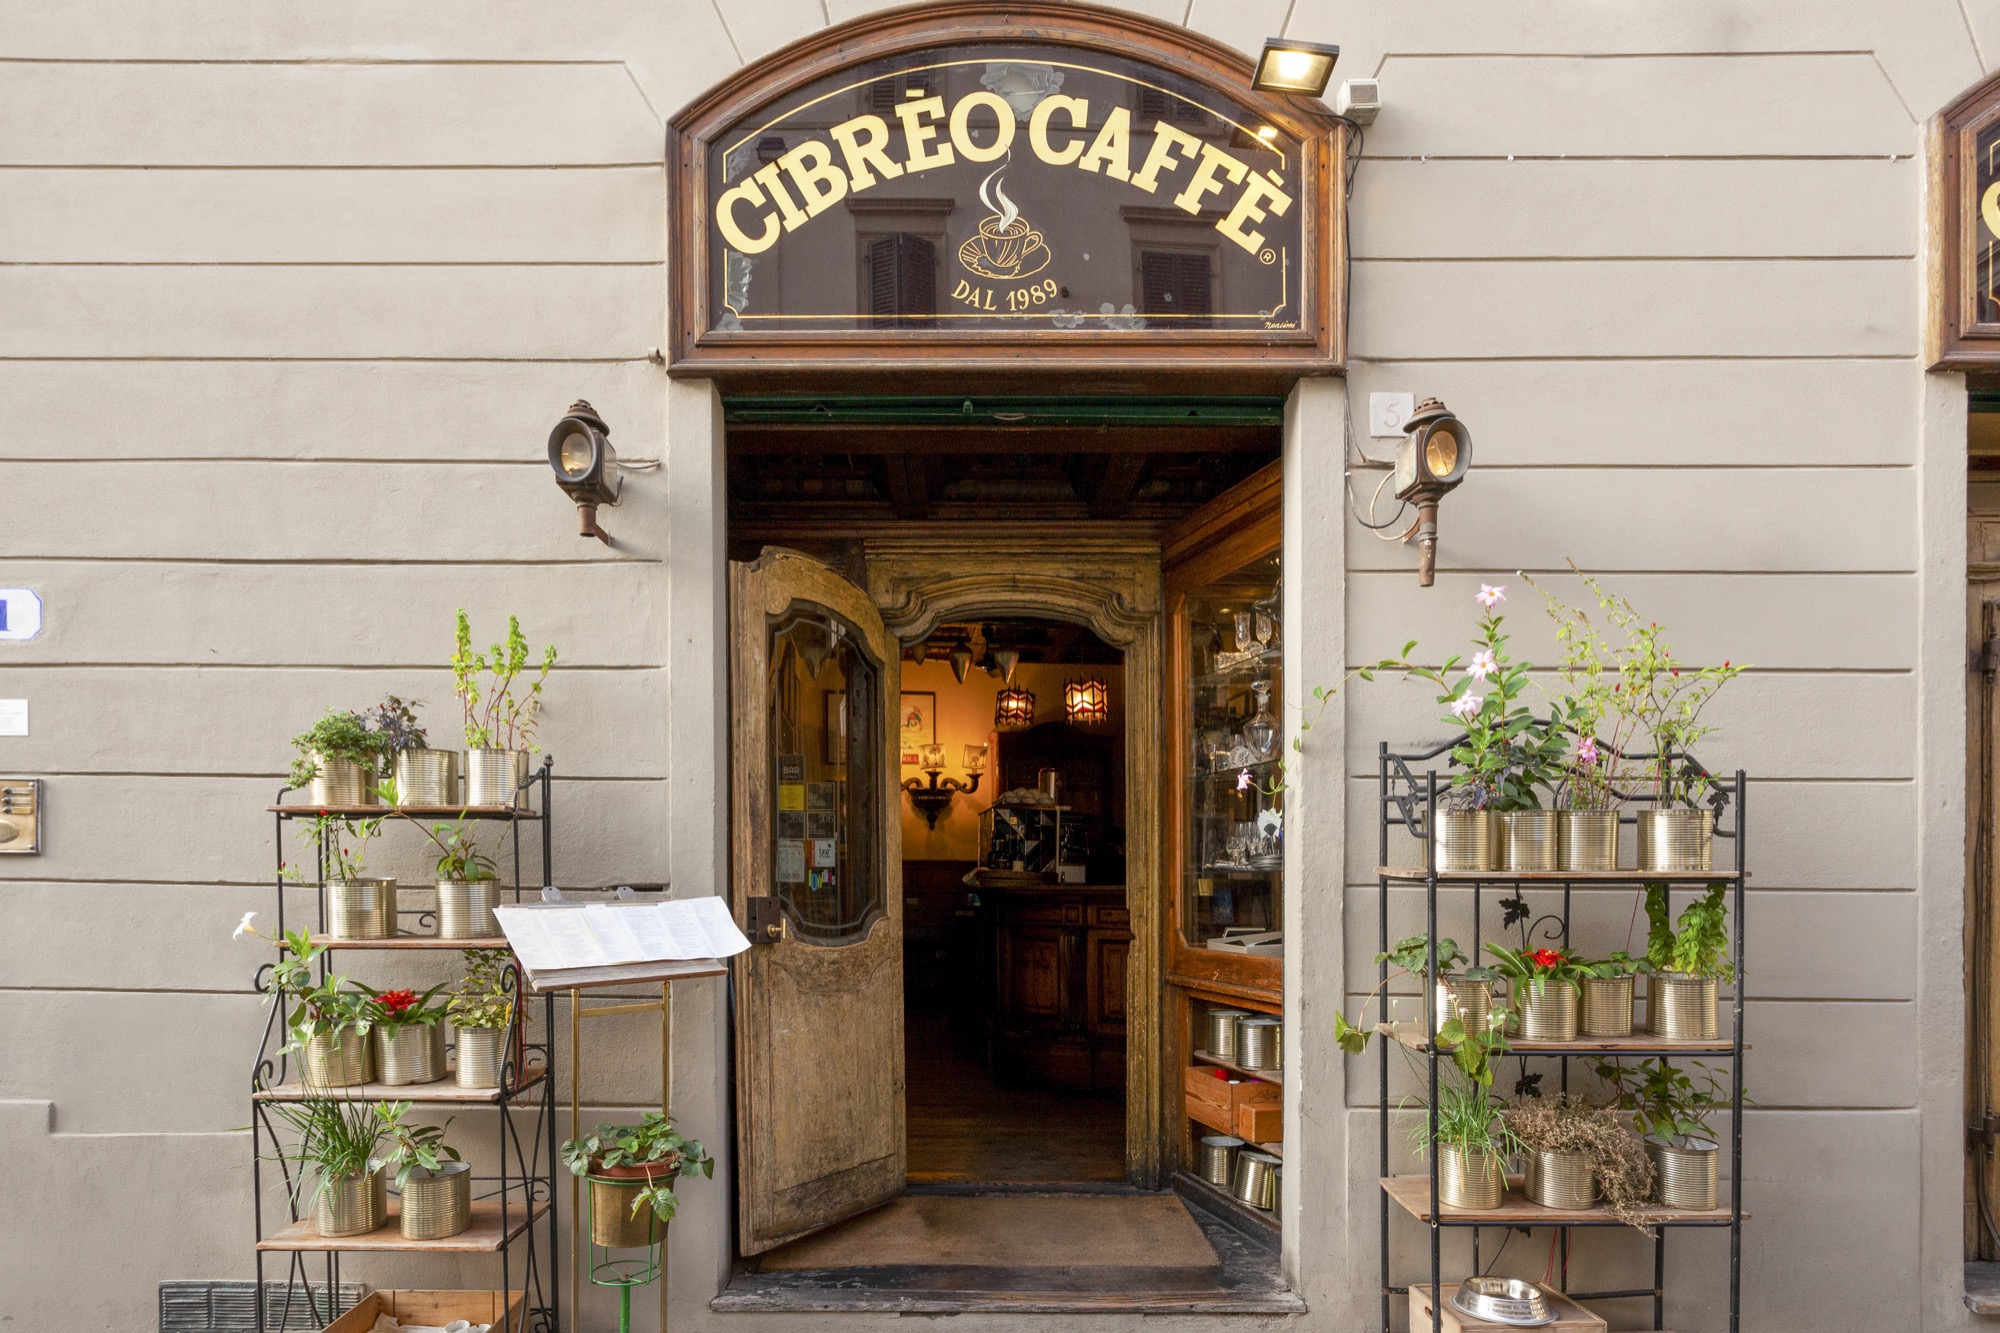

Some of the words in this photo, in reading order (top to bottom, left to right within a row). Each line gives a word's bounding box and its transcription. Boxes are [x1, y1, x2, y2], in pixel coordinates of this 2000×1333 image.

[716, 88, 1015, 255] CIBRÈO
[1029, 94, 1293, 255] CAFFÈ
[951, 279, 997, 311] DAL
[1006, 279, 1058, 311] 1989
[1383, 402, 1401, 428] 5
[783, 766, 800, 775] BAR
